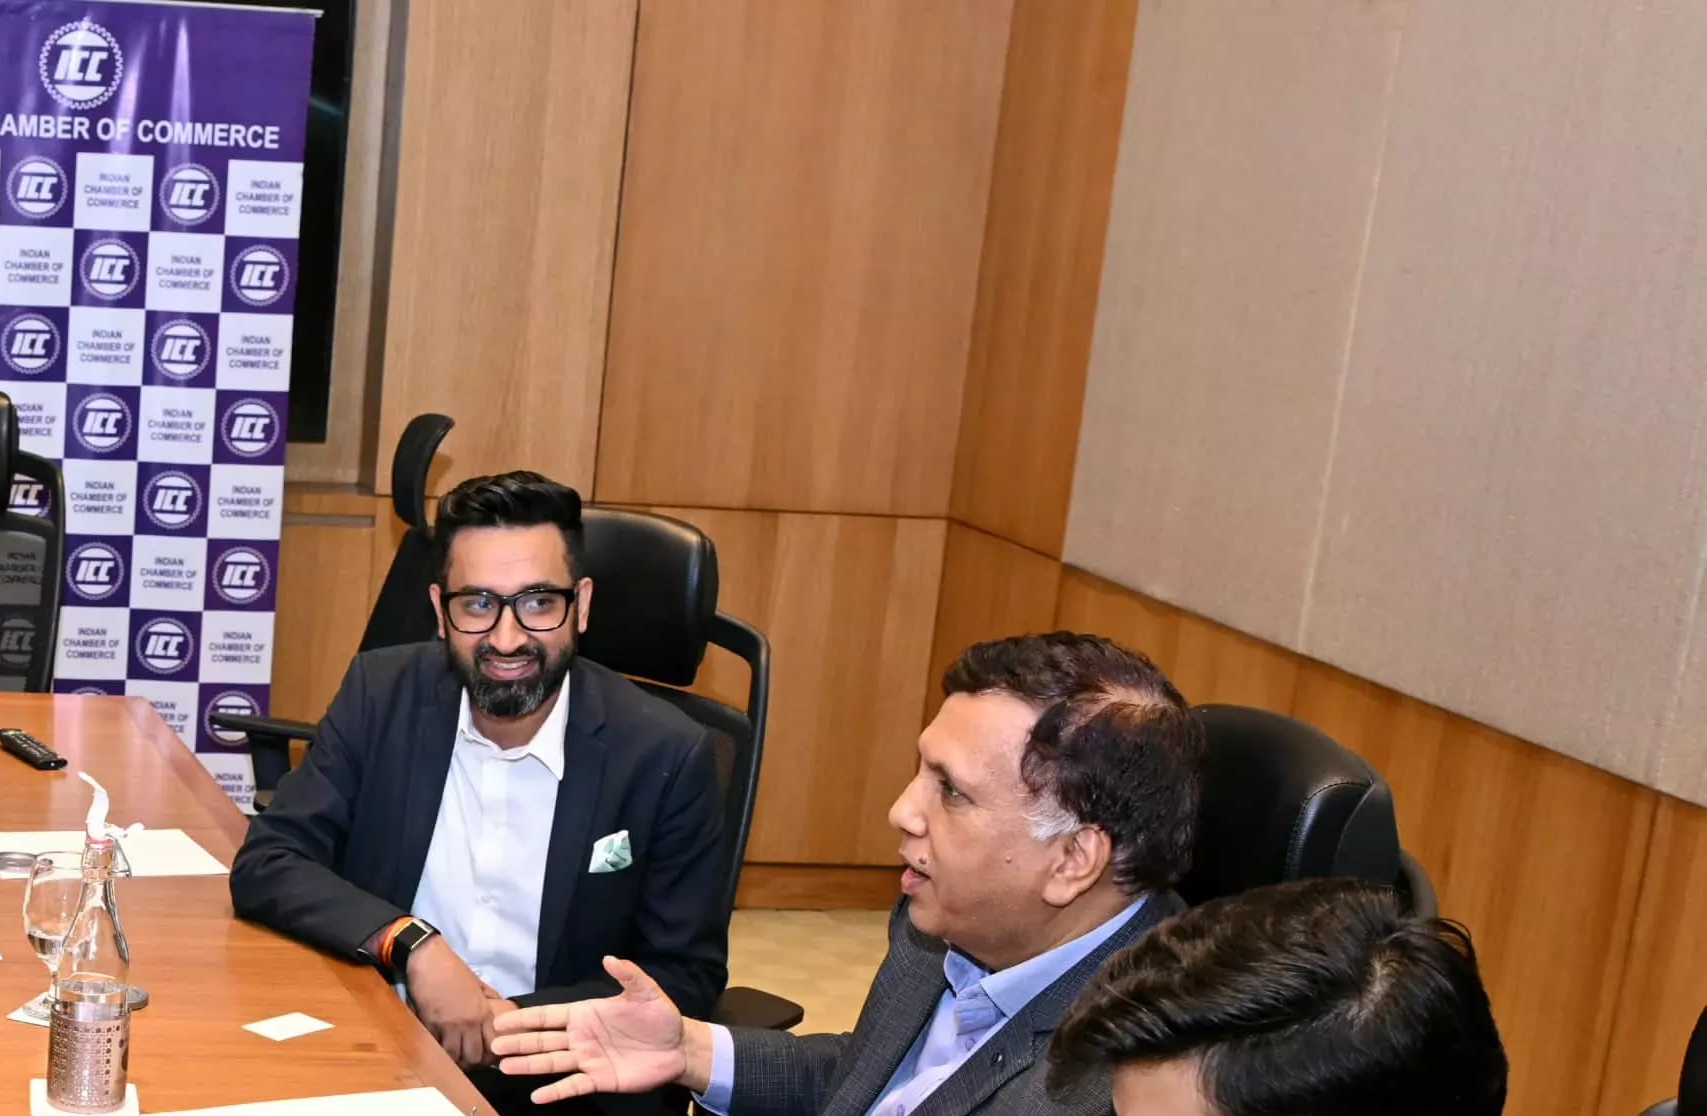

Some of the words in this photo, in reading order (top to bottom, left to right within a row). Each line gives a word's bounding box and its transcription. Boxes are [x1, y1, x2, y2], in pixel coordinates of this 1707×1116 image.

[54, 50, 108, 81] ICC
[96, 118, 130, 142] OF
[137, 120, 280, 149] COMMERCE
[17, 175, 58, 199] ICC
[251, 180, 281, 190] INDIAN
[169, 182, 210, 206] ICC
[236, 192, 280, 202] CHAMBER
[282, 194, 294, 203] OF
[239, 205, 290, 216] COMMERCE
[20, 249, 51, 258] INDIAN
[171, 255, 202, 265] INDIAN
[5, 261, 50, 271] CHAMBER
[51, 262, 64, 272] OF
[90, 258, 130, 281] ICC
[8, 273, 59, 284] COMMERCE
[156, 267, 201, 278] CHAMBER
[202, 269, 215, 279] OF
[241, 264, 279, 287] ICC
[159, 280, 211, 291] COMMERCE
[92, 329, 123, 339] INDIAN
[11, 333, 50, 355] ICC
[241, 336, 271, 345] INDIAN
[77, 341, 122, 351] CHAMBER
[123, 342, 136, 352] OF
[161, 338, 201, 361] ICC
[226, 347, 271, 357] CHAMBER
[272, 348, 284, 358] OF
[80, 353, 131, 364] COMMERCE
[229, 359, 279, 370] COMMERCE
[163, 409, 193, 418] INDIAN
[83, 411, 122, 434] ICC
[148, 420, 193, 430] CHAMBER
[194, 422, 206, 431] OF
[231, 417, 270, 439] ICC
[151, 432, 202, 443] COMMERCE
[85, 481, 115, 490] INDIAN
[232, 486, 262, 495] INDIAN
[70, 492, 114, 502] CHAMBER
[115, 493, 128, 502] OF
[154, 489, 192, 511] ICC
[217, 497, 261, 507] CHAMBER
[262, 498, 275, 507] OF
[73, 504, 123, 514] COMMERCE
[220, 509, 270, 519] COMMERCE
[76, 561, 114, 581] ICC
[223, 565, 260, 586] ICC
[78, 628, 108, 636] INDIAN
[63, 638, 107, 648] CHAMBER
[108, 639, 120, 648] OF
[146, 635, 184, 656] ICC
[66, 650, 116, 660] COMMERCE
